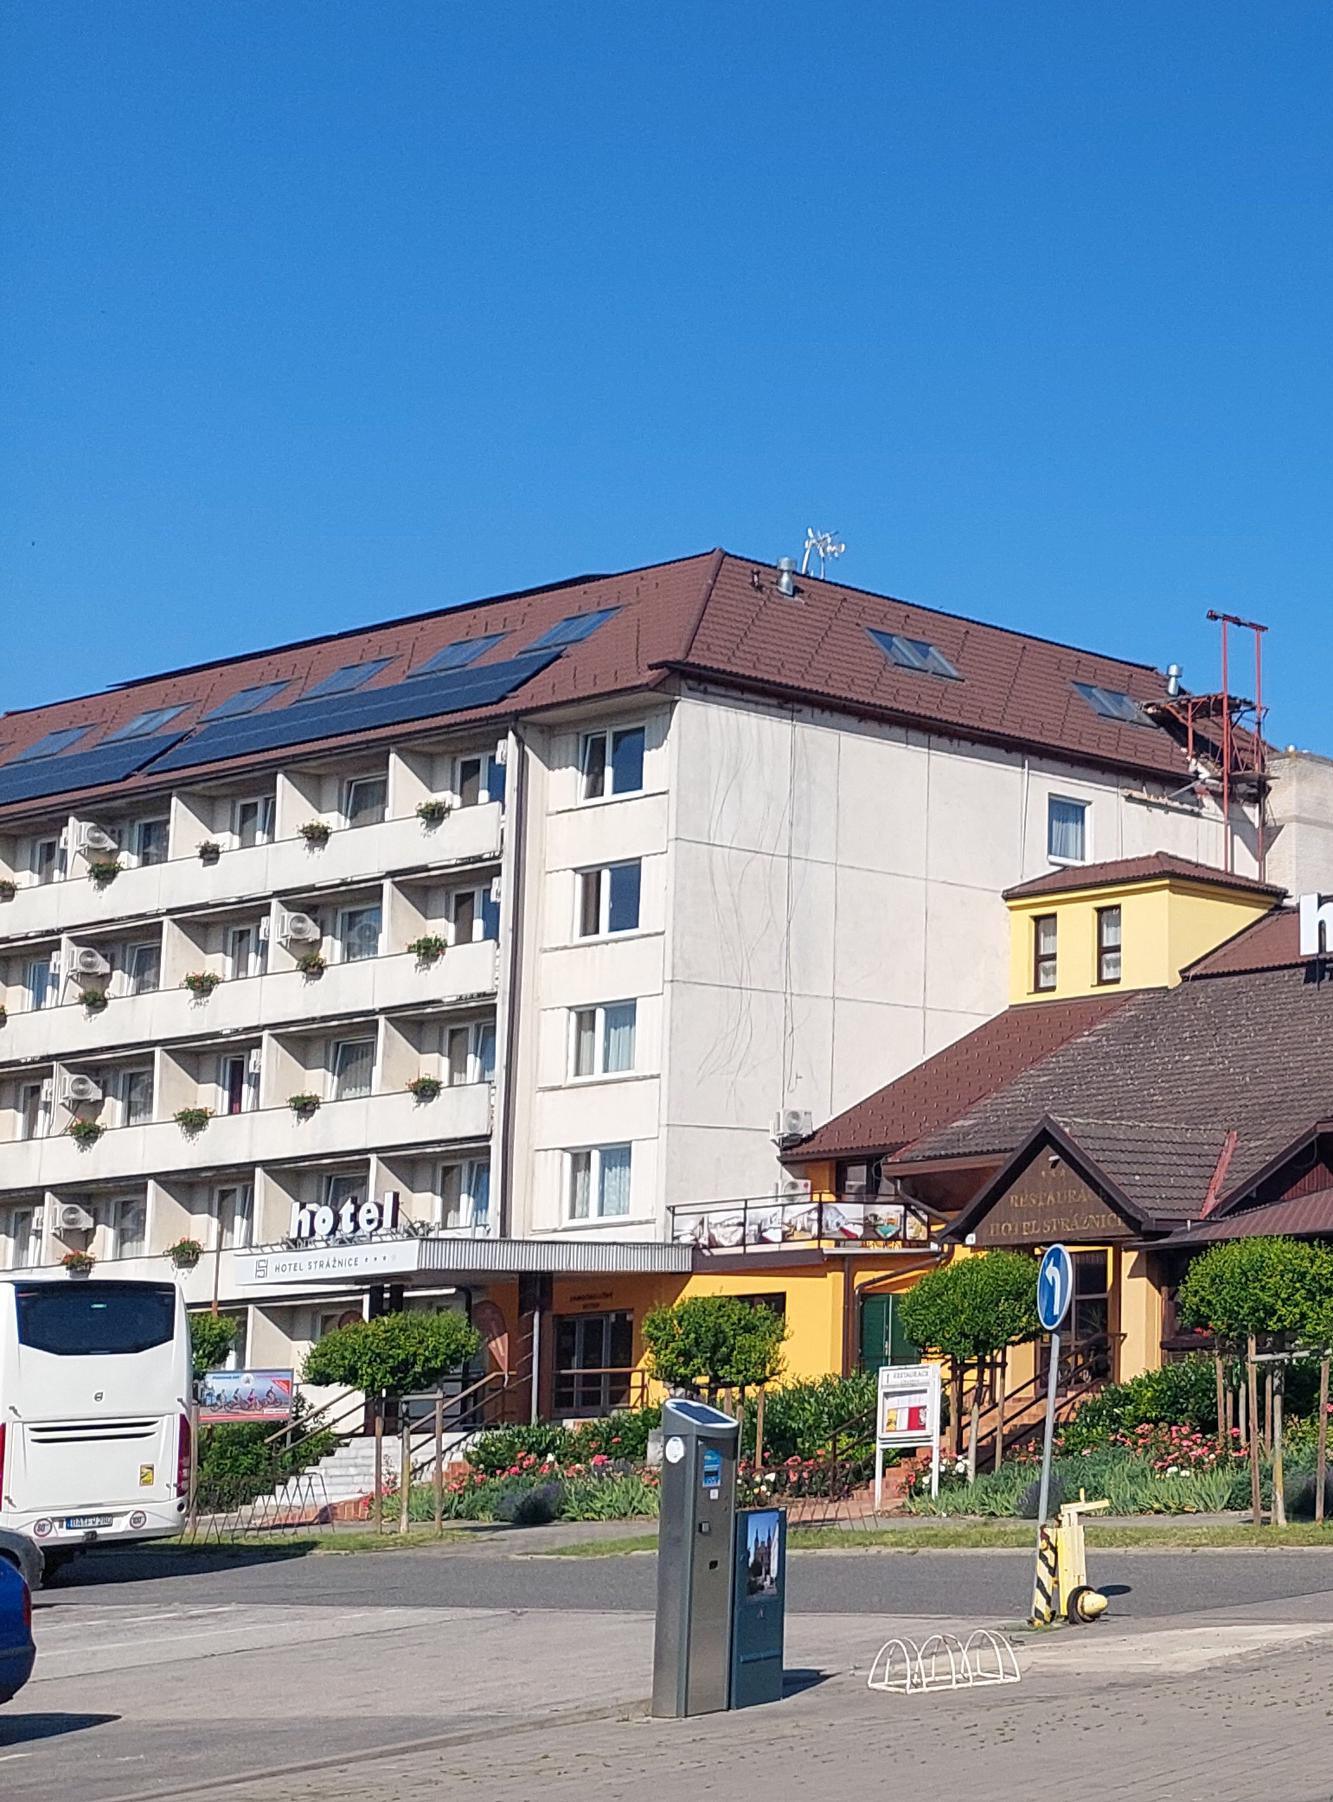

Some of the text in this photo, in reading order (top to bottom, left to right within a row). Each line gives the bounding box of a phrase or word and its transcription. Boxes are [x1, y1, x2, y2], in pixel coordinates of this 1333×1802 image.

[290, 1191, 399, 1238] hotel
[989, 1220, 1040, 1237] HOTEL
[274, 1256, 359, 1273] HOTEL STRÁŽNICE
